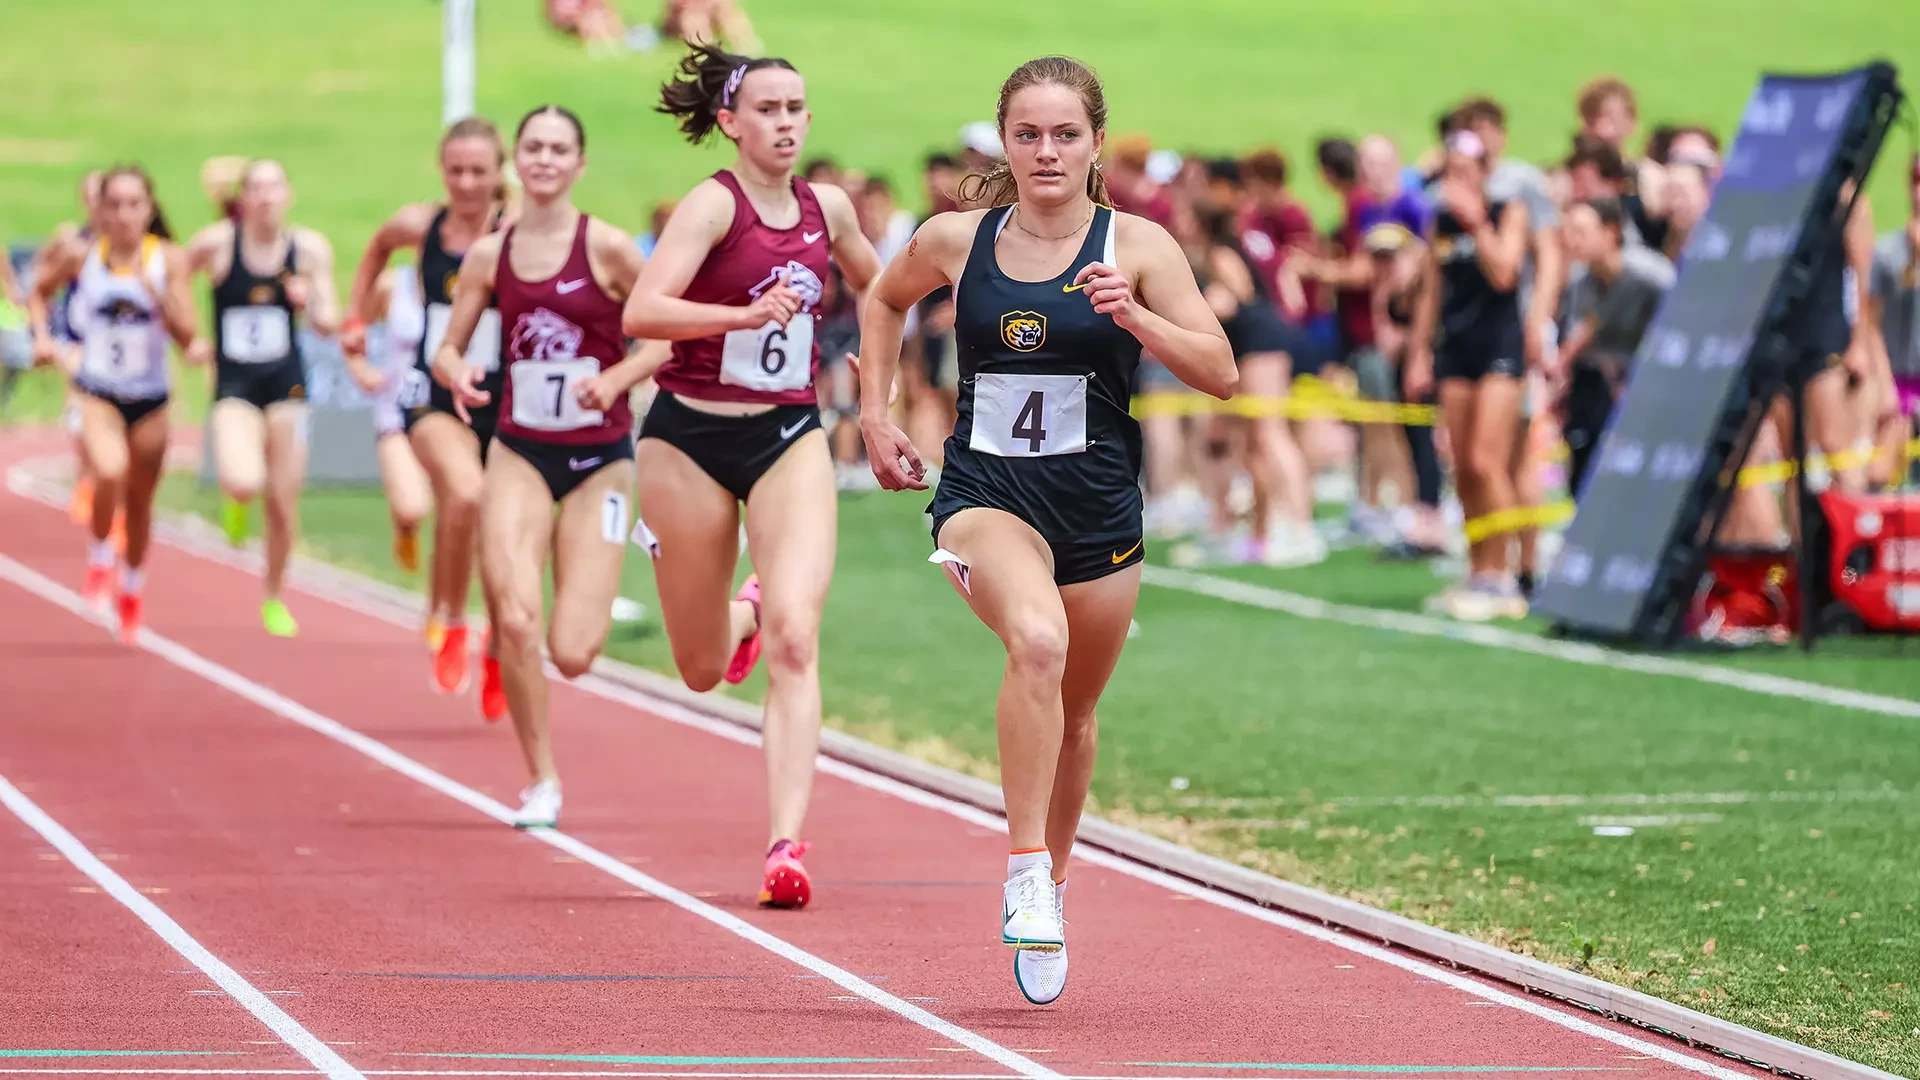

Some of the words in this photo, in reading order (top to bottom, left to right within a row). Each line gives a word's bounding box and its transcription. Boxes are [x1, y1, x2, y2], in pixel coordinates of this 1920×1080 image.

[761, 329, 788, 375] 6
[546, 374, 565, 417] 7
[1011, 390, 1046, 453] 4
[607, 497, 619, 537] 7
